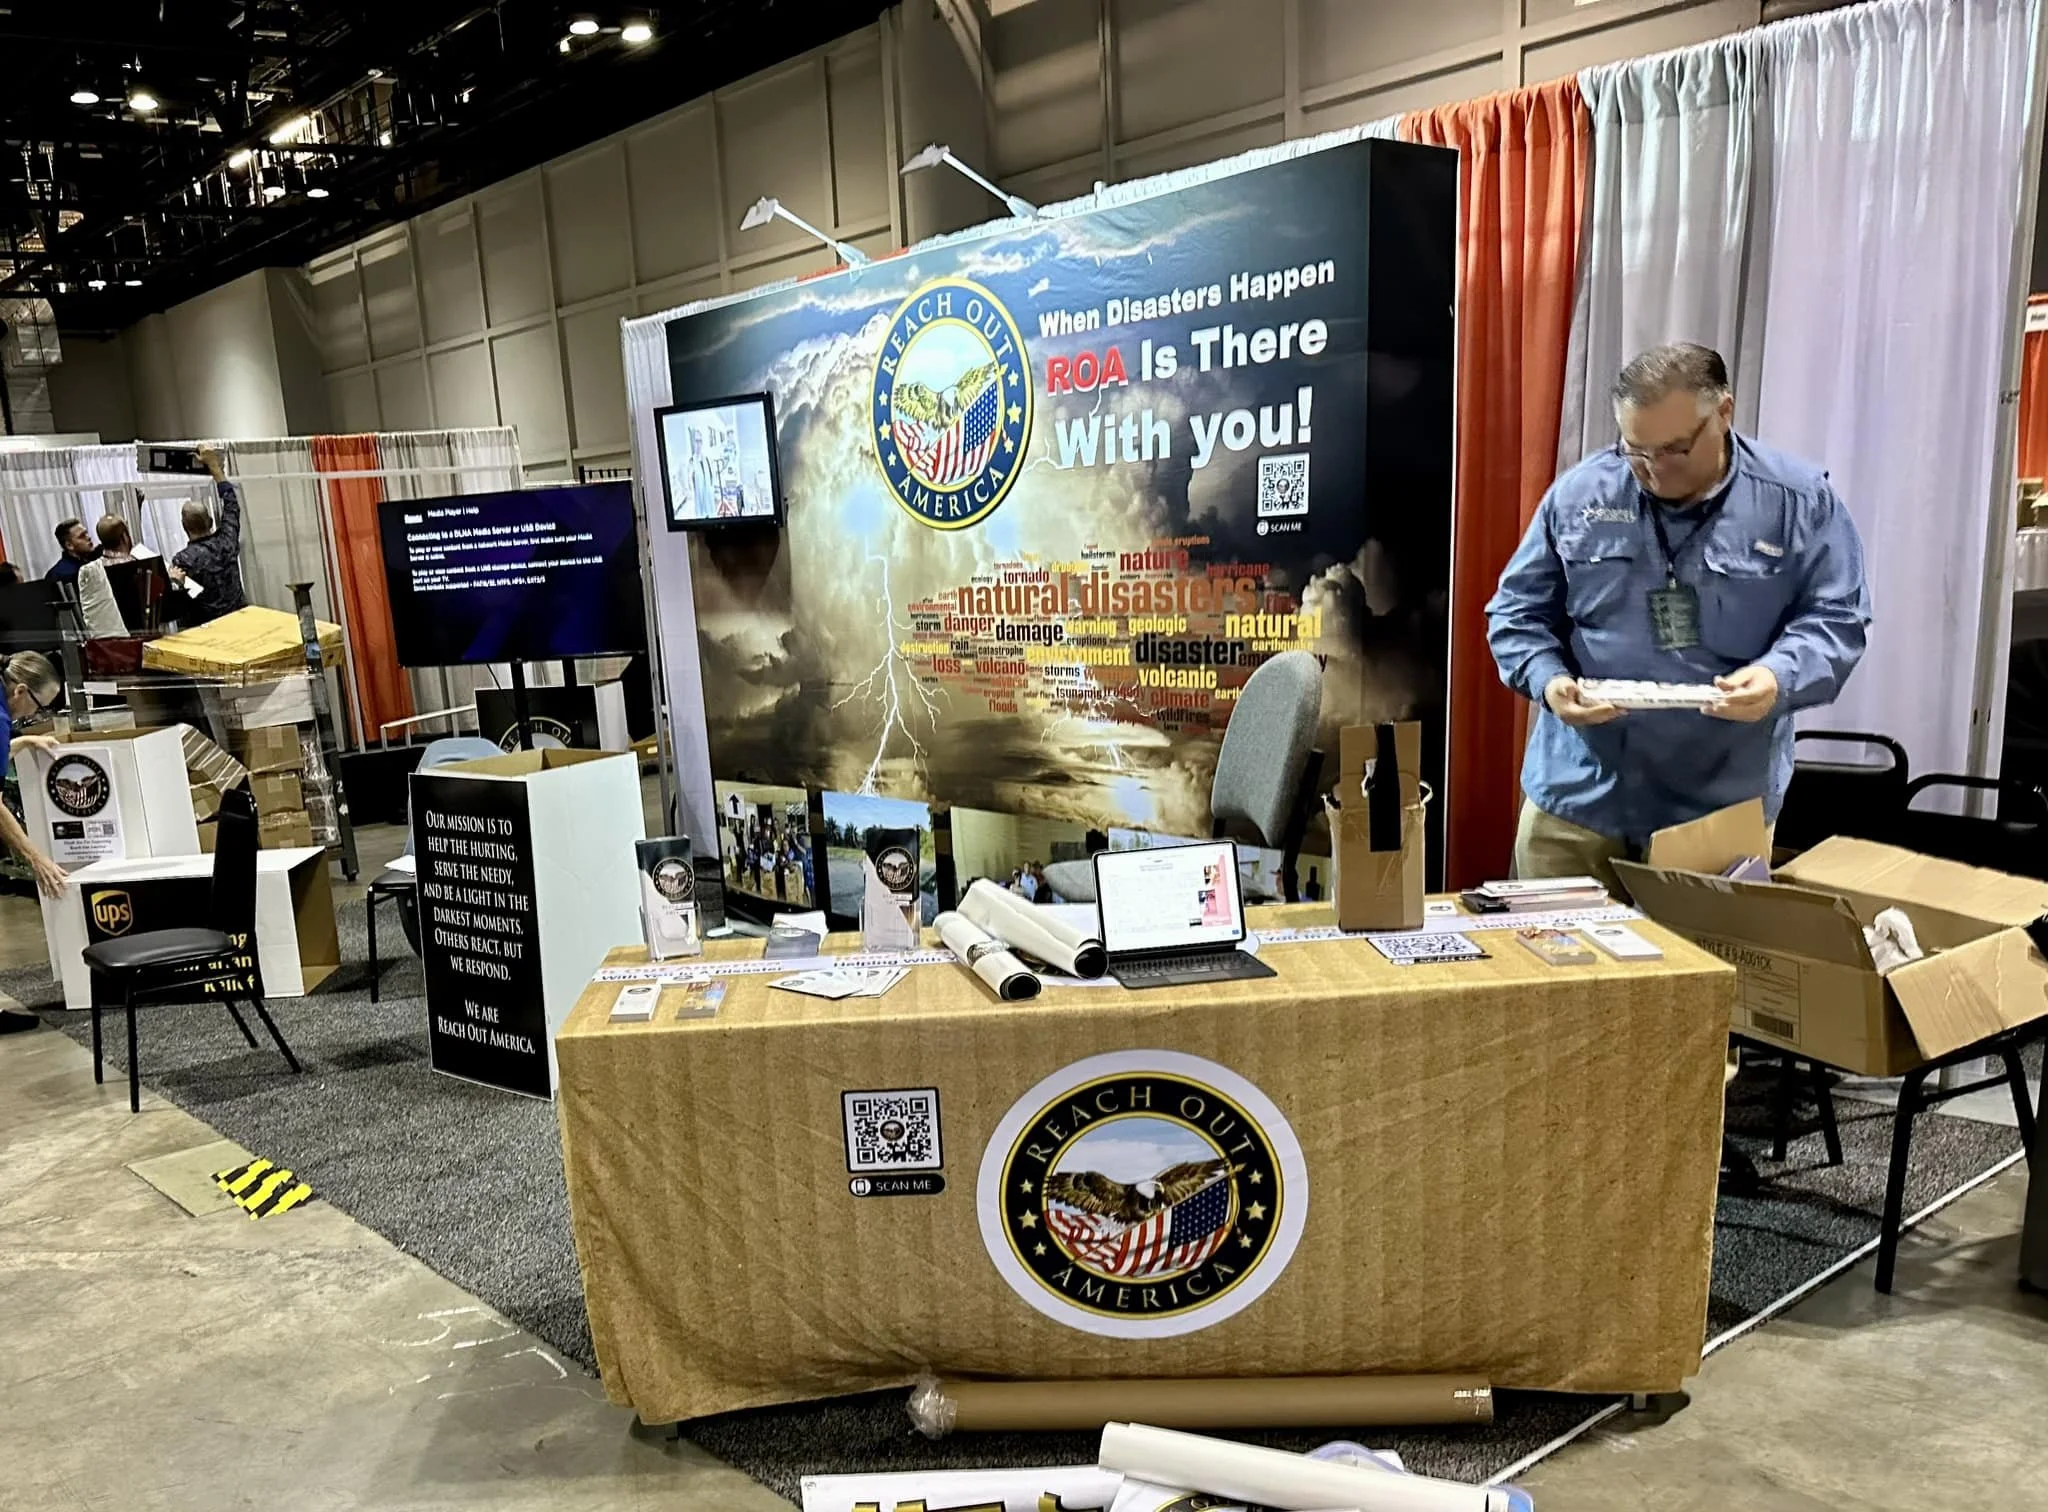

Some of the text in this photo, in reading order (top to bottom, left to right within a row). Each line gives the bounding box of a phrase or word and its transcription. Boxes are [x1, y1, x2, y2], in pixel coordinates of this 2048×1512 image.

[1038, 259, 1335, 339] When Disasters Happen
[881, 292, 1014, 377] REACH OUT
[1046, 319, 1329, 397] ROA Is There
[1054, 385, 1313, 469] With you!
[898, 466, 1006, 518] AMERICA
[1270, 522, 1290, 533] SCAN
[1081, 550, 1116, 560] hailstorms
[1120, 546, 1188, 571] nature
[1004, 567, 1050, 584] tornado
[1206, 560, 1270, 577] hurricane
[958, 571, 1069, 616] natural
[1080, 571, 1257, 616] disasters
[908, 601, 957, 612] environmental
[916, 619, 941, 632] storm
[944, 612, 995, 637] danger
[996, 618, 1064, 646] damage
[1065, 617, 1117, 639] warning
[1129, 613, 1187, 637] geologic
[1225, 606, 1322, 638] natural
[900, 640, 950, 655] destruction
[950, 638, 969, 651] rain
[978, 645, 1024, 657] catastrophe
[1067, 634, 1107, 647] eruptions
[1136, 633, 1244, 665] disaster
[933, 653, 961, 673] loss
[975, 656, 1026, 675] volcano
[1026, 643, 1131, 666] environment
[1044, 664, 1081, 677] storms
[1138, 663, 1217, 690] volcanic
[989, 699, 1018, 713] floods
[1151, 690, 1209, 709] climate
[447, 814, 485, 834] MISSION
[487, 818, 496, 835] IS
[497, 819, 513, 836] TO
[427, 836, 518, 864] HELP THE HURTING,
[434, 860, 515, 887] SERVE THE NEEDY,
[424, 882, 529, 912] AND BE A LIGHT IN THE
[96, 904, 131, 929] ups
[433, 906, 524, 935] DARKEST MOMENTS.
[471, 936, 501, 957] REACT,
[503, 941, 523, 959] BUT
[465, 958, 511, 981] RESPOND.
[714, 967, 782, 975] Disaster
[481, 1005, 500, 1024] ARE
[1026, 1085, 1259, 1163] REACH OUT
[876, 1179, 932, 1192] SCAN ME
[1052, 1261, 1237, 1310] AMERICA
